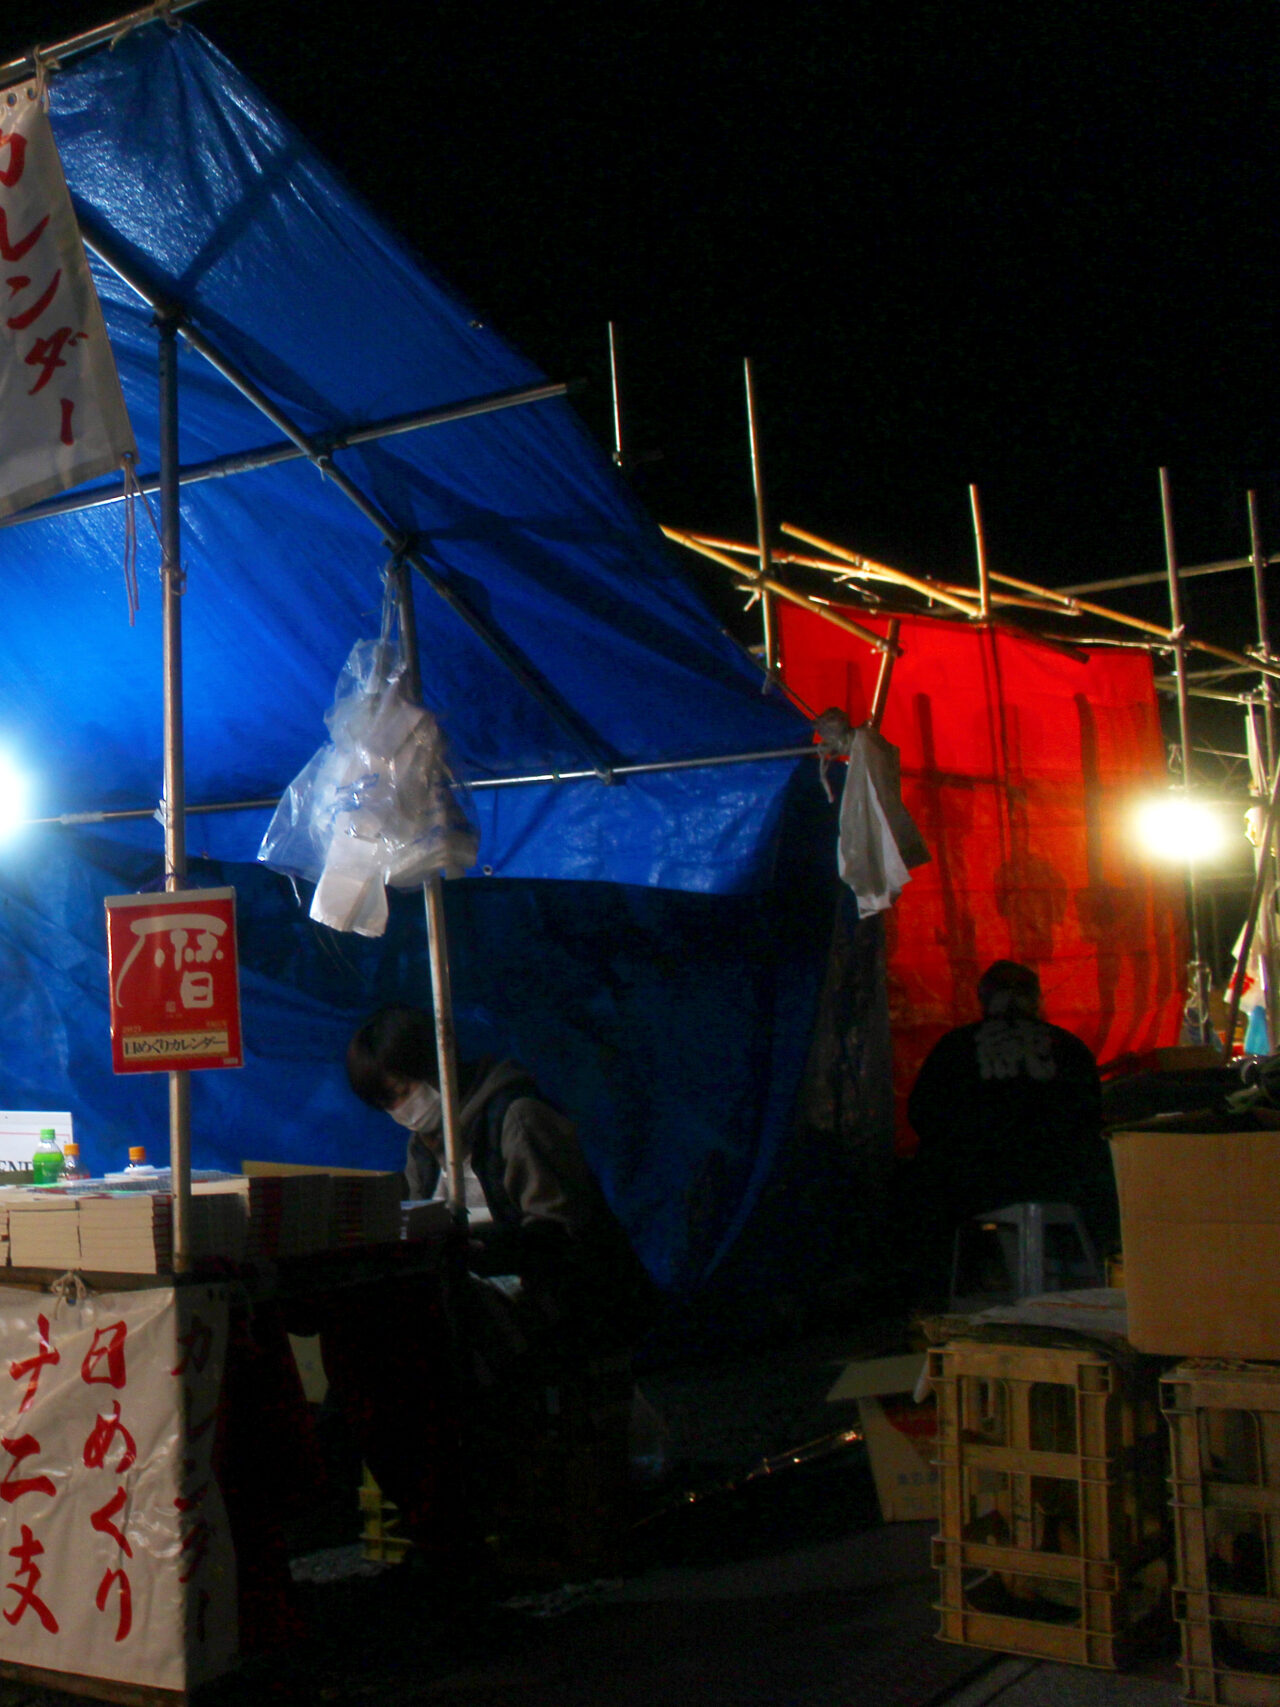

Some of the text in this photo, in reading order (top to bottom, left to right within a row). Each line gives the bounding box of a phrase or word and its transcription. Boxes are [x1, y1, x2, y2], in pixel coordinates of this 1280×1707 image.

[0, 1312, 61, 1634] 十二支
[81, 1320, 138, 1642] 日めくり
